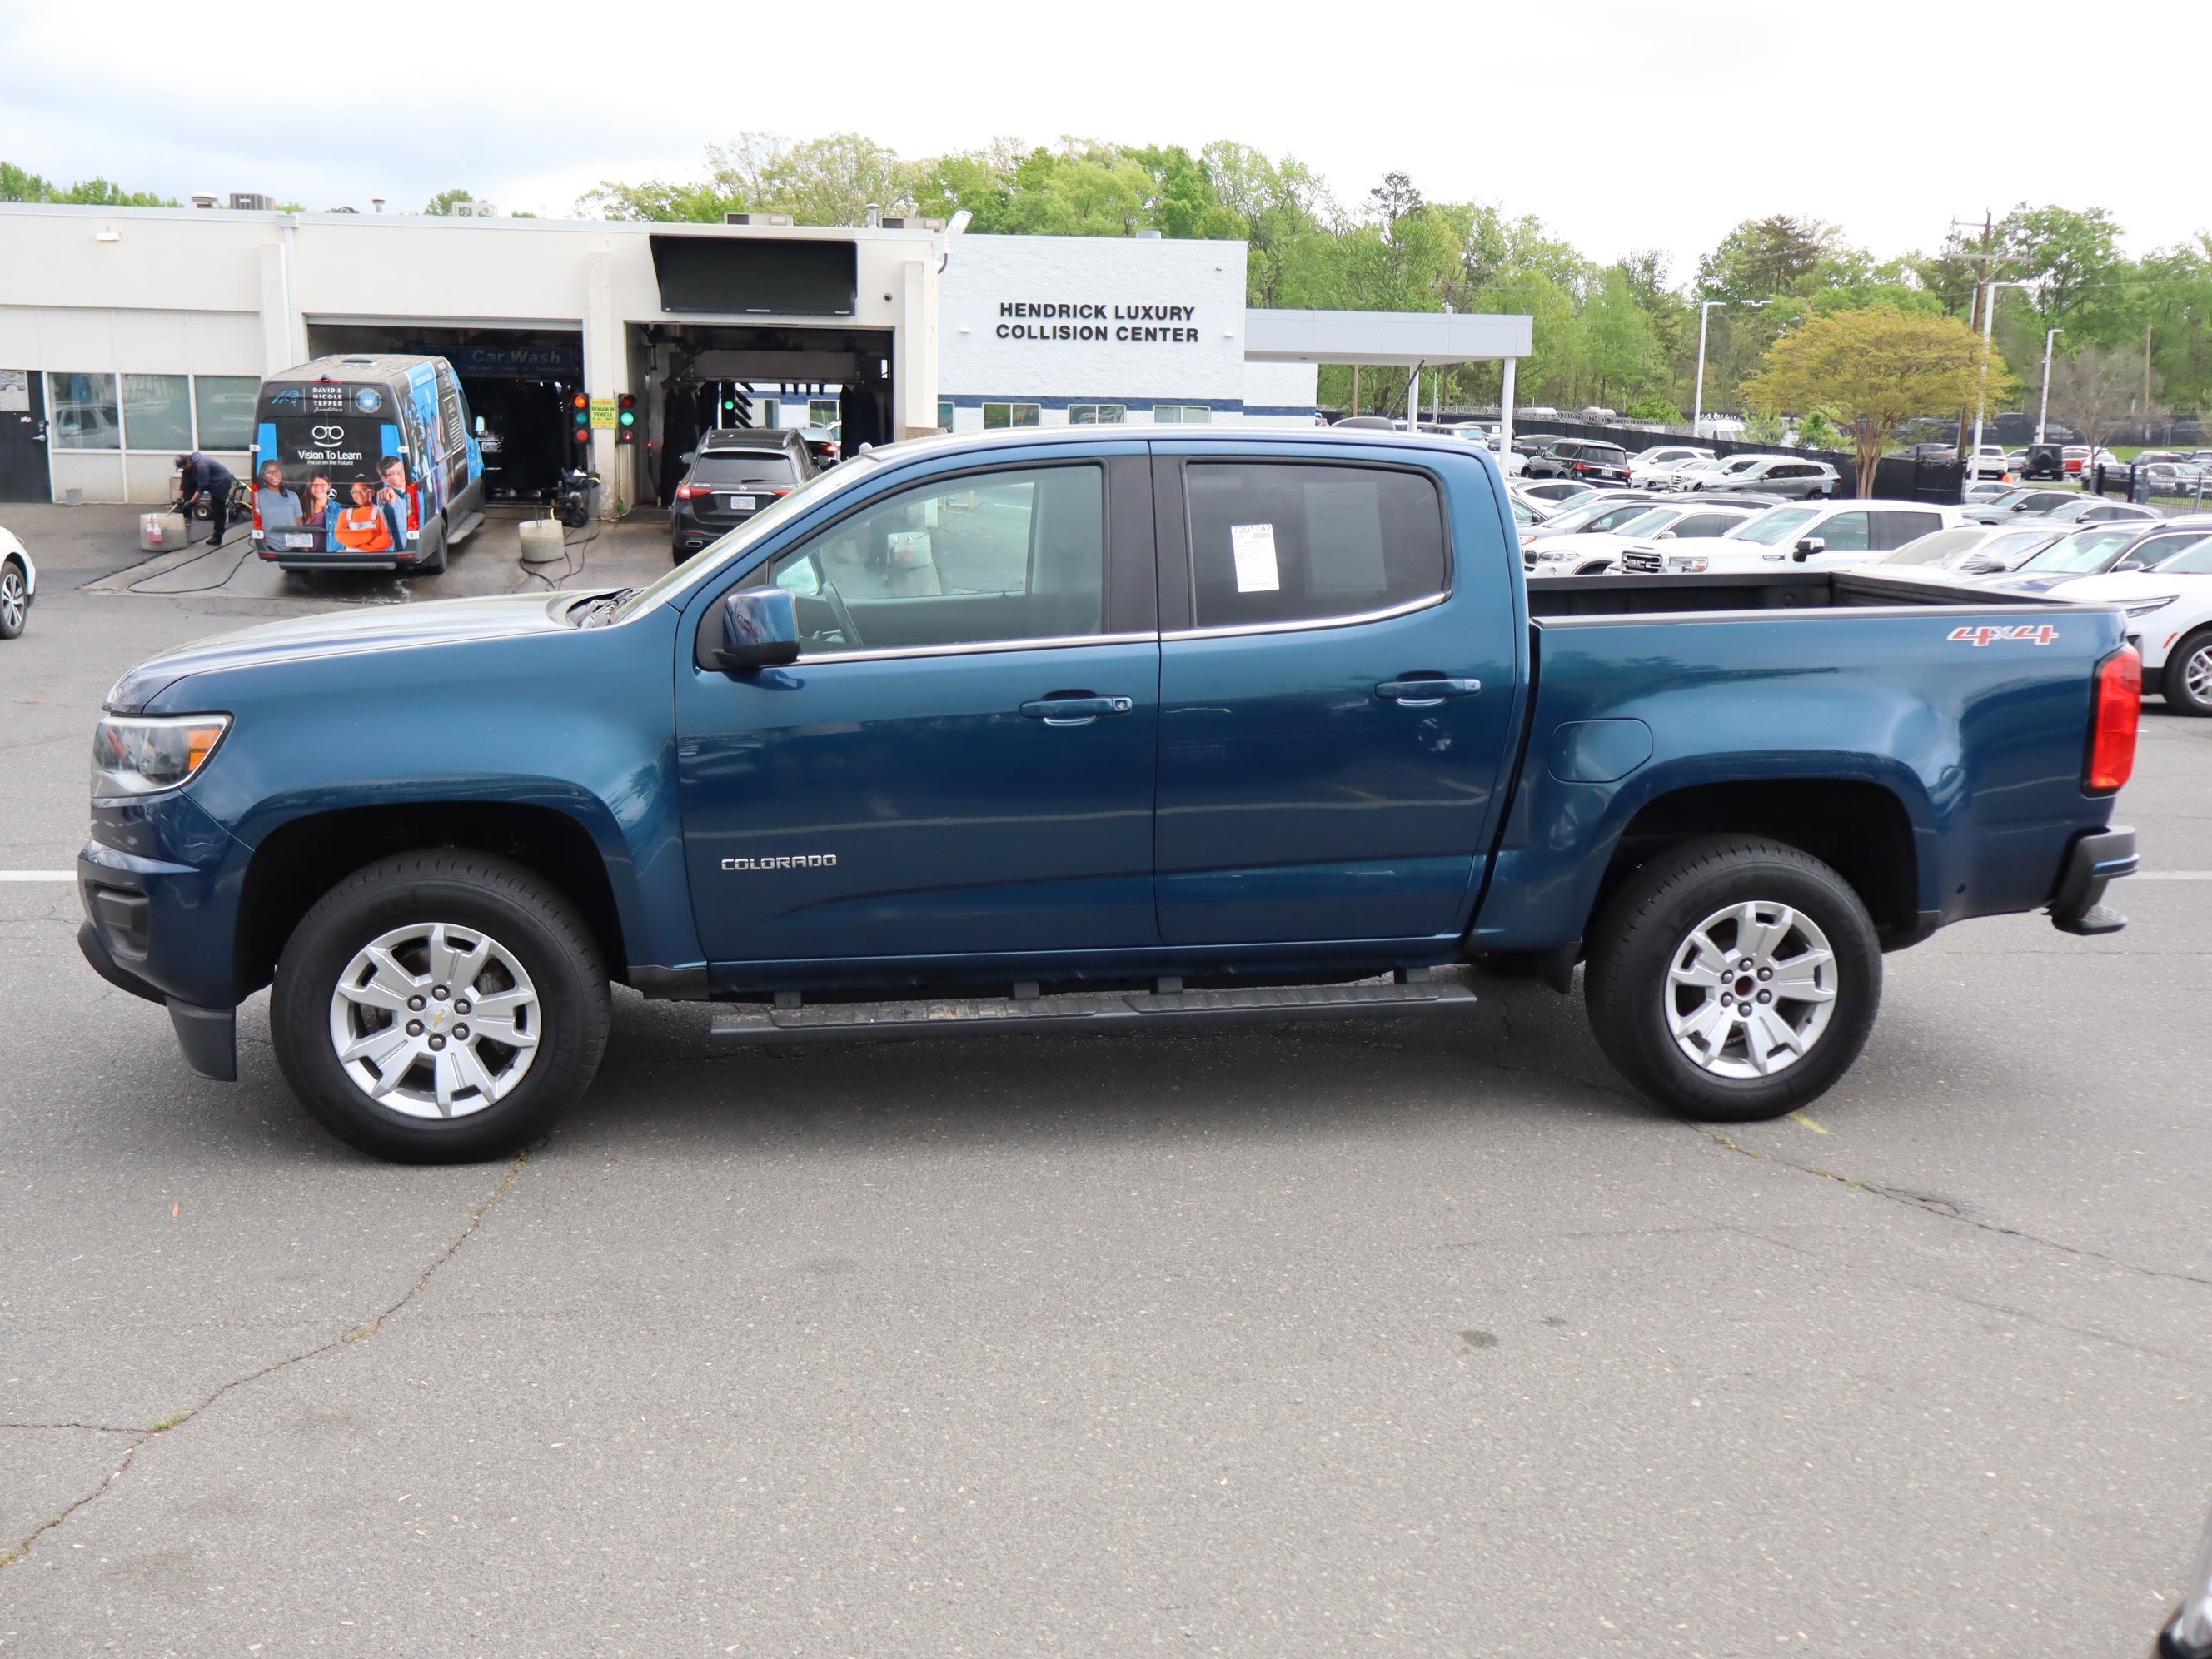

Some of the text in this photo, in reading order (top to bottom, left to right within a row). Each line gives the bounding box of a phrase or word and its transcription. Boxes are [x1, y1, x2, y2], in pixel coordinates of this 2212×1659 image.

[999, 302, 1196, 321] HENDRICK LUXURY
[996, 324, 1199, 342] COLLISION CENTER
[471, 349, 560, 365] Car Wash
[297, 449, 362, 461] Vision To Learn
[1233, 524, 1272, 534] 7301742
[720, 854, 838, 871] COLORADO
